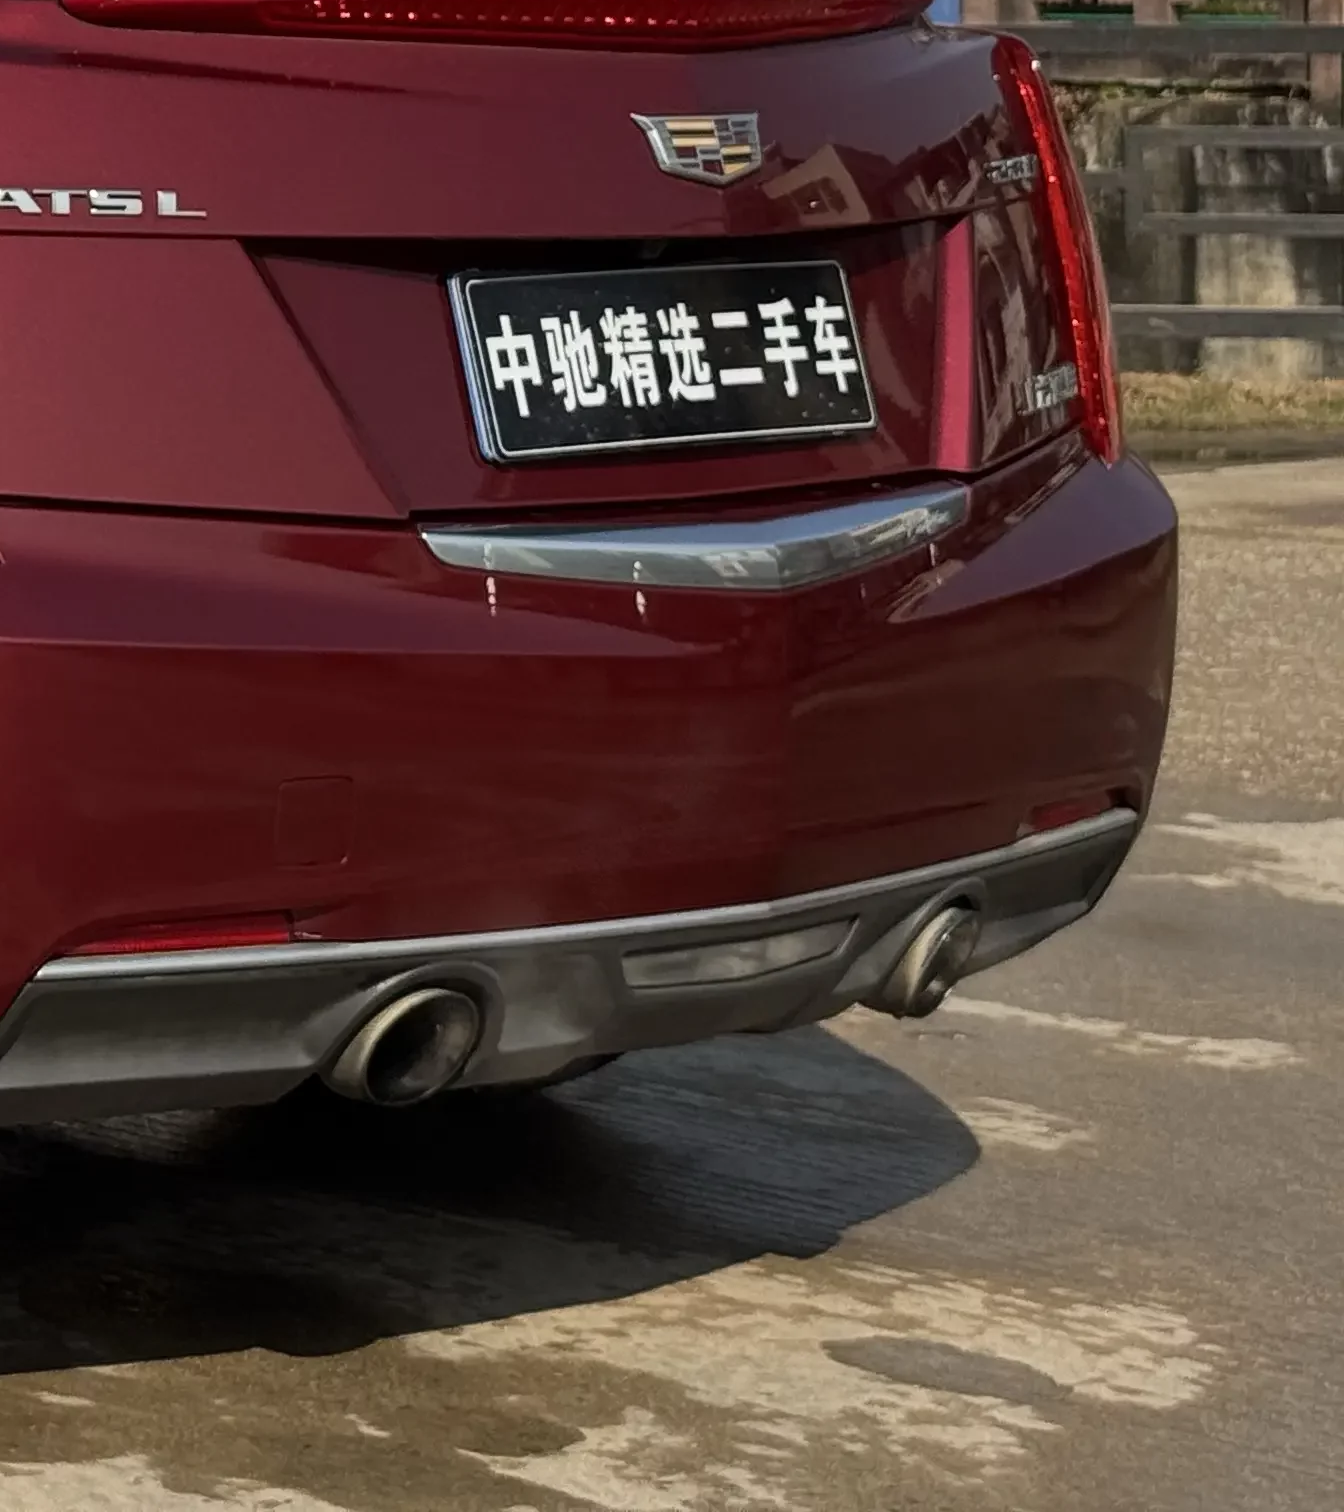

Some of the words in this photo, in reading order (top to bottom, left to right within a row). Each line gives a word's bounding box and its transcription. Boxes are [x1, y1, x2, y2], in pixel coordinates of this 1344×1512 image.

[485, 296, 860, 419] 中驰精选二手车
